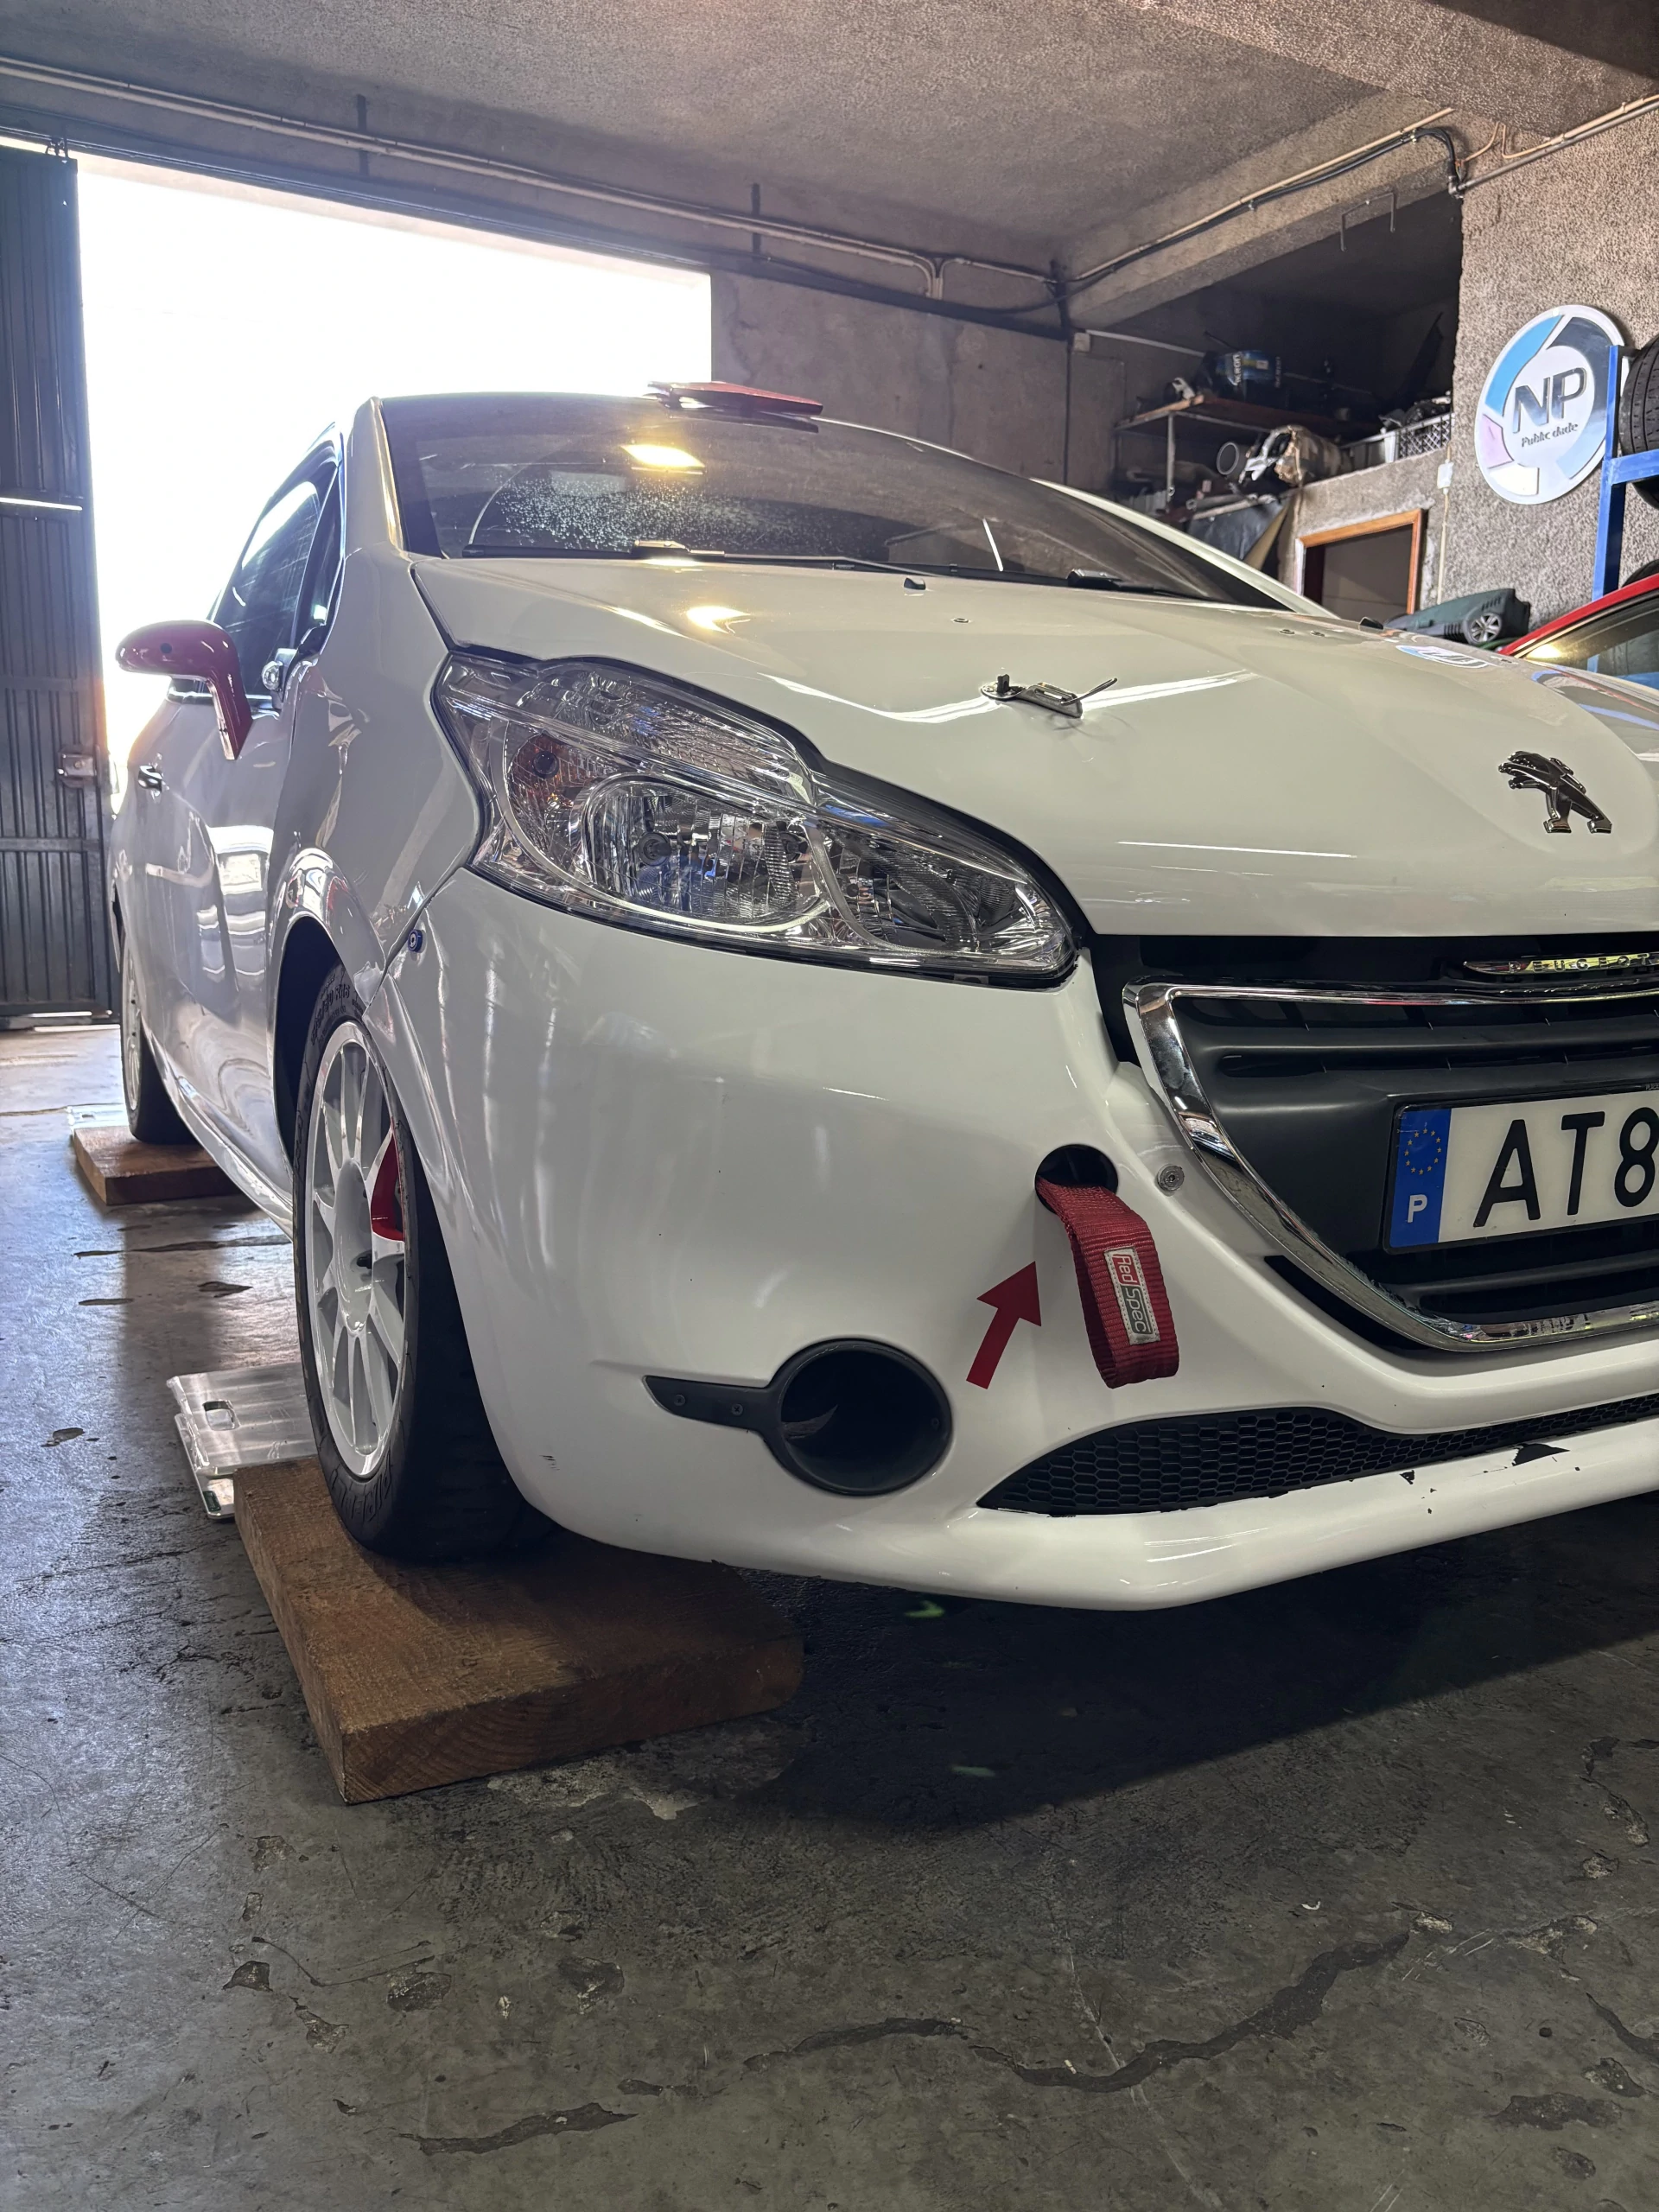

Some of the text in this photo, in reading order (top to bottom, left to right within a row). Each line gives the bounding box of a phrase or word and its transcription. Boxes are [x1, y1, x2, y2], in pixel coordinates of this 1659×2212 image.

[1513, 367, 1586, 434] NP
[1509, 953, 1649, 973] PEUGEOT
[1407, 1194, 1428, 1223] P
